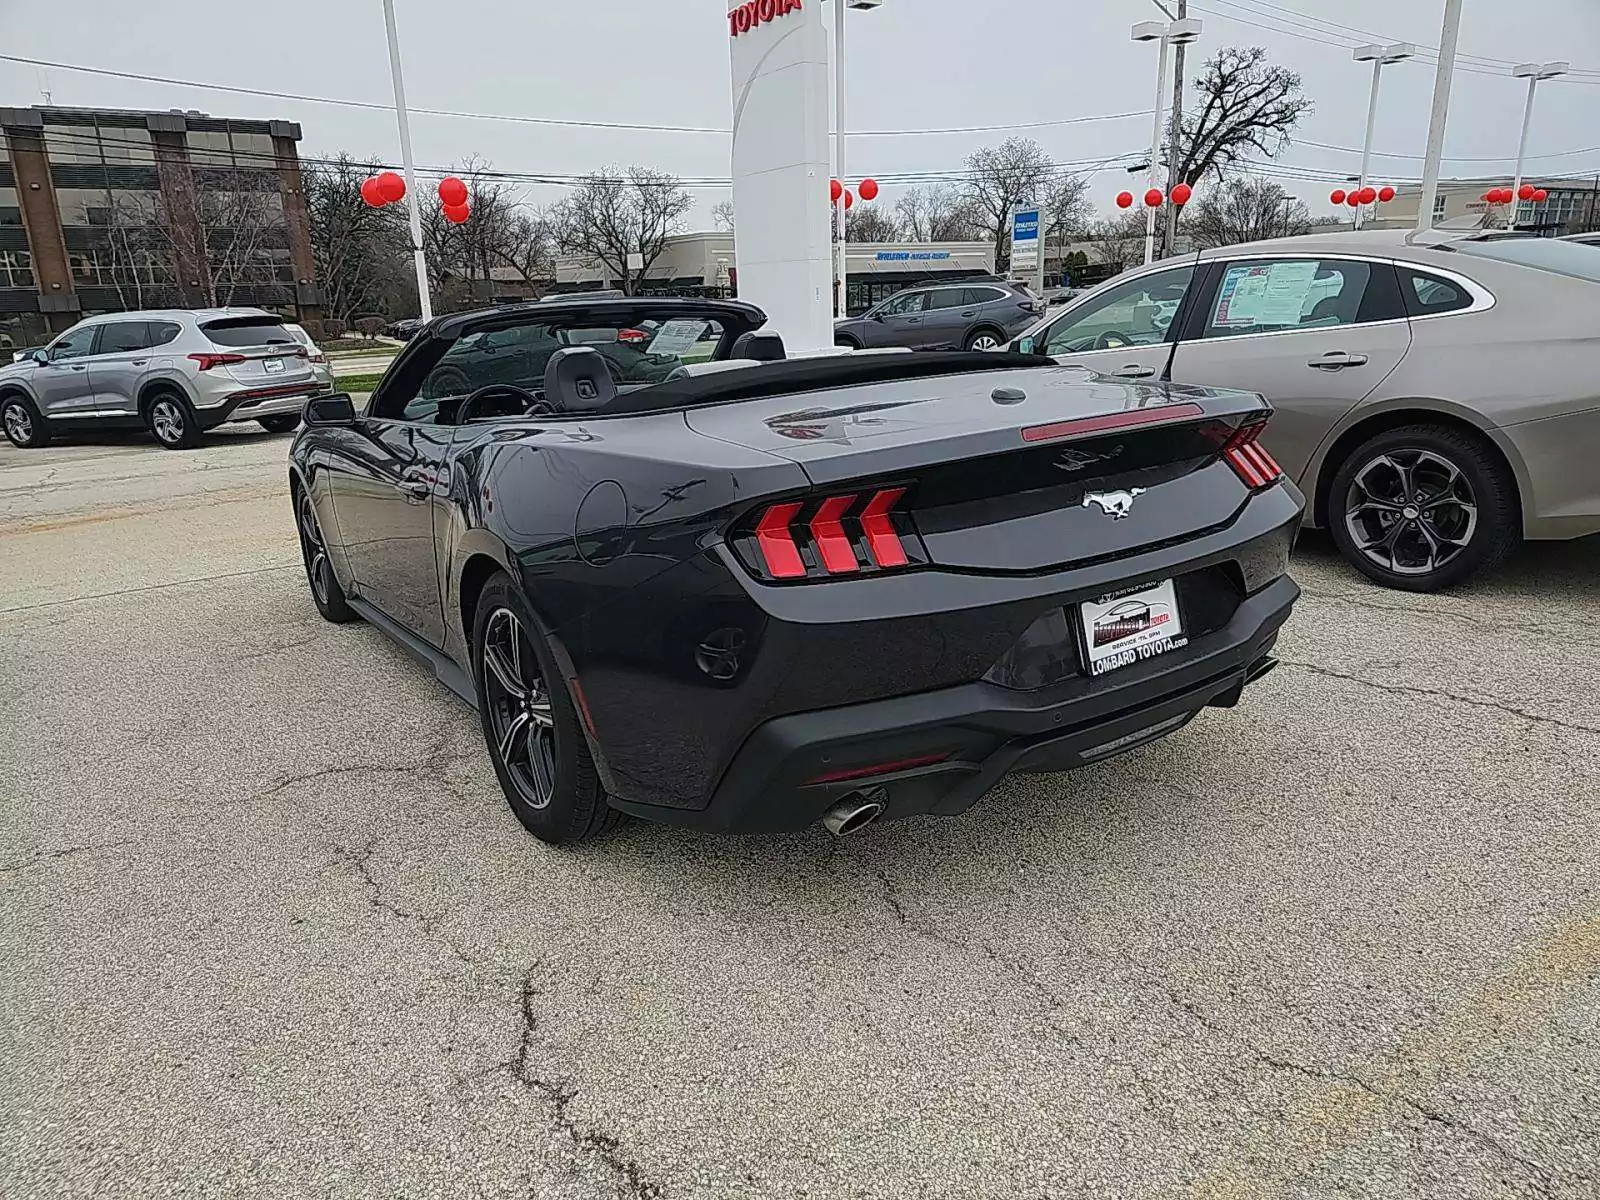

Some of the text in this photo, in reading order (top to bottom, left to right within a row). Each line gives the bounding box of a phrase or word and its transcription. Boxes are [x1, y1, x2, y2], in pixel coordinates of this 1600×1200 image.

[1150, 613, 1170, 625] TOYOTA
[1091, 637, 1188, 676] LOMBARD TOYOTA.com
